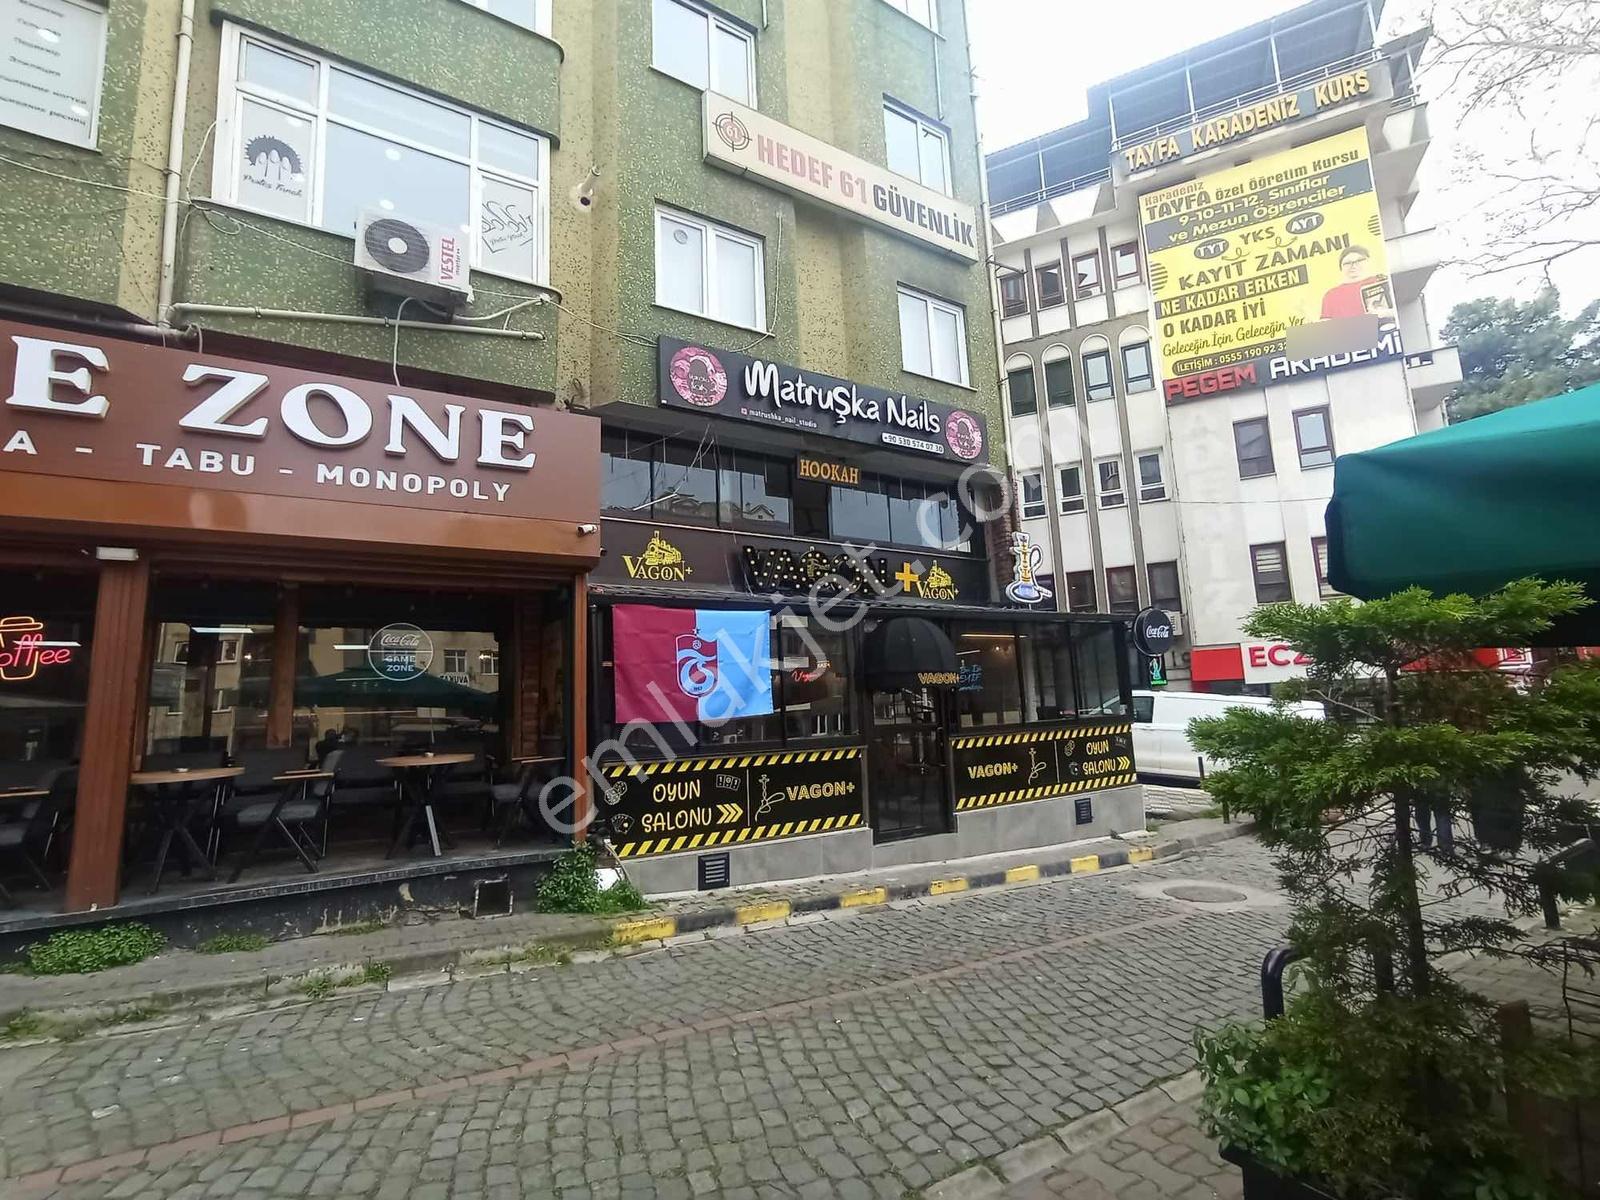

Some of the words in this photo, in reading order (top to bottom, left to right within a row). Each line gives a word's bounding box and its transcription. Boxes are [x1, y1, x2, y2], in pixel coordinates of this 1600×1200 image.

[726, 124, 740, 140] 61
[1124, 138, 1181, 171] TAYFA
[1191, 94, 1300, 150] KARADENİZ
[1313, 70, 1370, 108] KURS
[757, 133, 833, 189] HEDEF
[839, 169, 868, 204] 61
[872, 183, 975, 248] GÜVENLİK
[1146, 190, 1212, 220] TAYFA
[1312, 150, 1359, 172] Kursu
[1268, 174, 1330, 199] Sınıflar
[1168, 230, 1188, 242] ve
[1192, 214, 1249, 237] Mezun
[1254, 184, 1346, 219] Öğrenciler
[1197, 241, 1226, 257] TYT
[1239, 226, 1276, 246] YKS
[1290, 215, 1320, 232] AYT
[440, 237, 455, 280] VESTEL
[1179, 260, 1247, 291] KAYIT
[1255, 232, 1351, 272] ZAMANI
[1160, 298, 1181, 316] NE
[1185, 284, 1240, 310] KADAR
[1245, 269, 1300, 296] ERKEN
[1163, 322, 1175, 338] O
[1180, 308, 1237, 335] KADAR
[1242, 297, 1267, 321] İYİ
[1162, 338, 1210, 357] Geleceğin
[1211, 331, 1234, 348] İçin
[1235, 322, 1286, 341] Geleceğin
[1176, 358, 1213, 373] İLETİŞİM
[1219, 352, 1242, 364] 0555
[1244, 347, 1261, 359] 190
[1263, 344, 1276, 354] 92
[1165, 363, 1257, 400] PEGEM
[178, 363, 537, 470] ZONE
[749, 409, 818, 429] matrushka_nail_studio
[886, 394, 941, 433] Nails
[136, 443, 256, 476] TABU
[316, 463, 511, 502] MONOPOLY
[799, 459, 860, 484] HOOKAH
[386, 664, 415, 672] ZONE
[1086, 739, 1109, 755] OYUN
[968, 762, 1019, 779] VAGON+
[1082, 758, 1116, 776] SALONU
[653, 779, 701, 803] OYUN
[786, 781, 856, 801] VAGON+
[641, 807, 712, 833] SALONU
